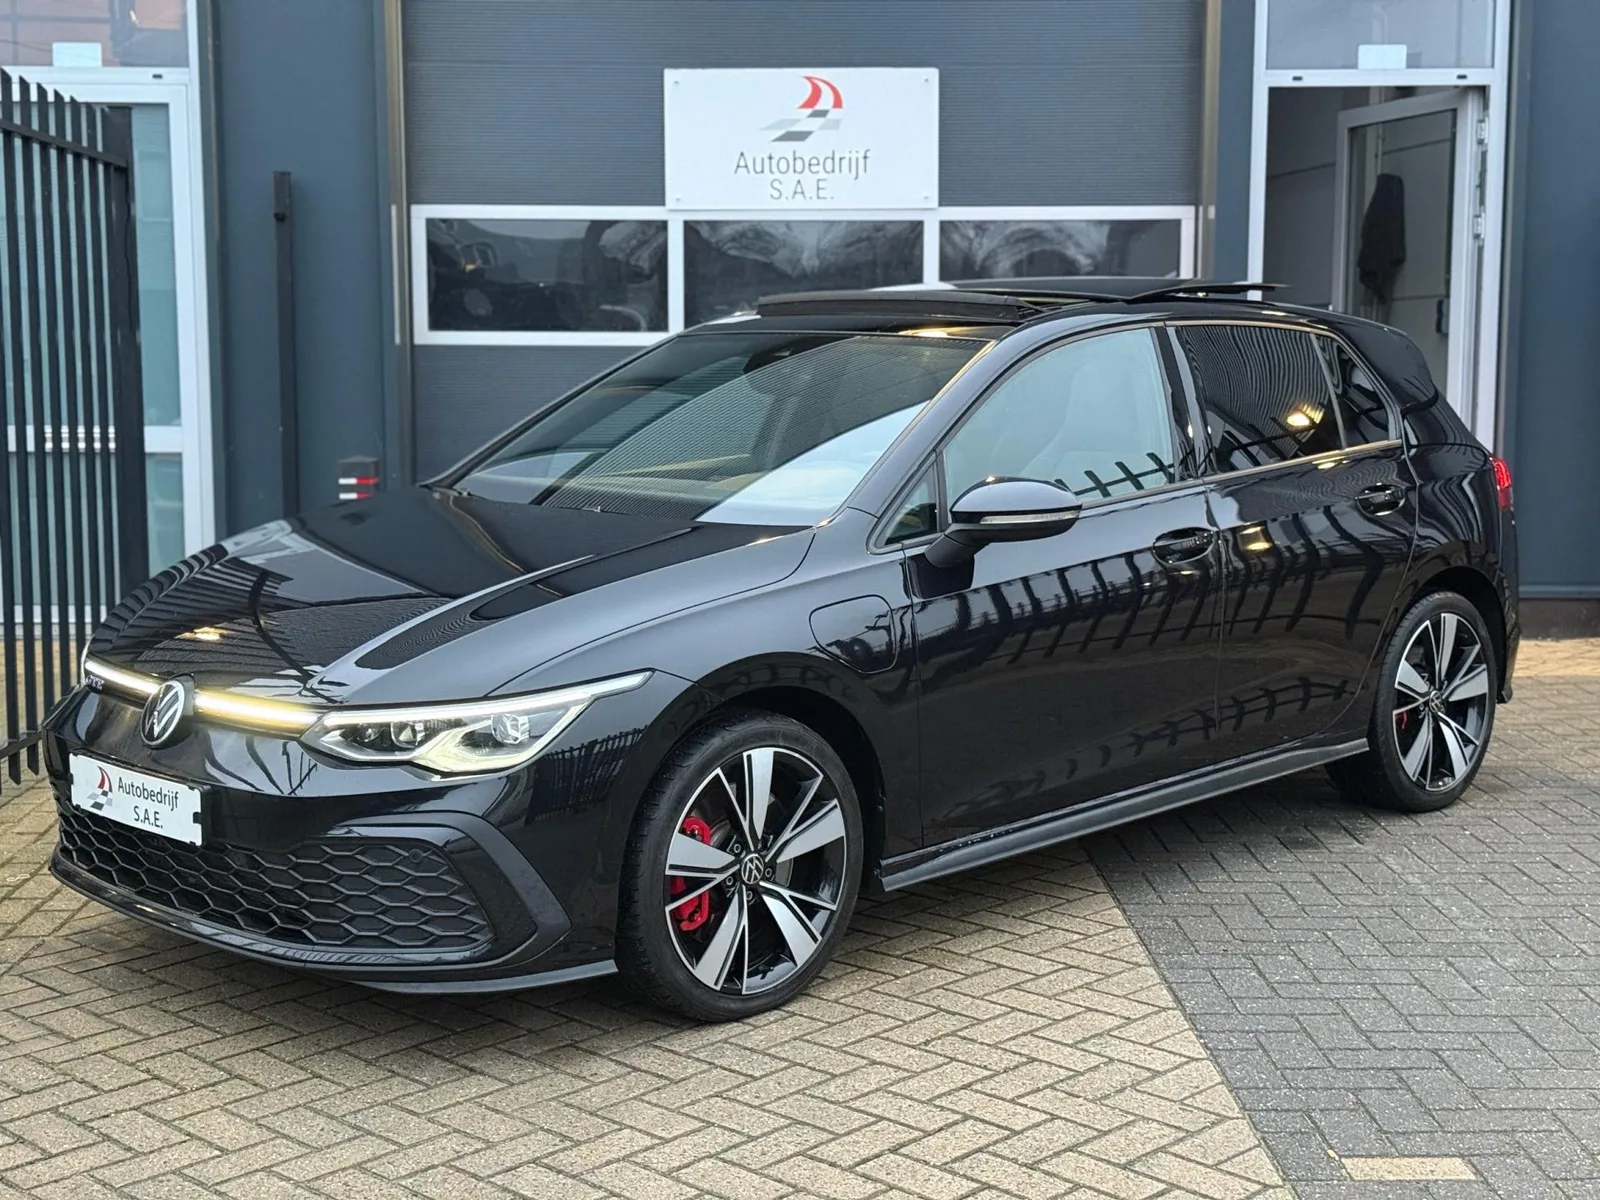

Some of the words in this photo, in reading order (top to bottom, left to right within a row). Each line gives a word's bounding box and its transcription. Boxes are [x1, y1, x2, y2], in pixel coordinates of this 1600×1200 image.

[734, 149, 871, 180] Autobedrijf
[770, 179, 834, 200] S.A.E.
[117, 777, 179, 811] Autobedrijf
[133, 805, 163, 829] S.A.E.
